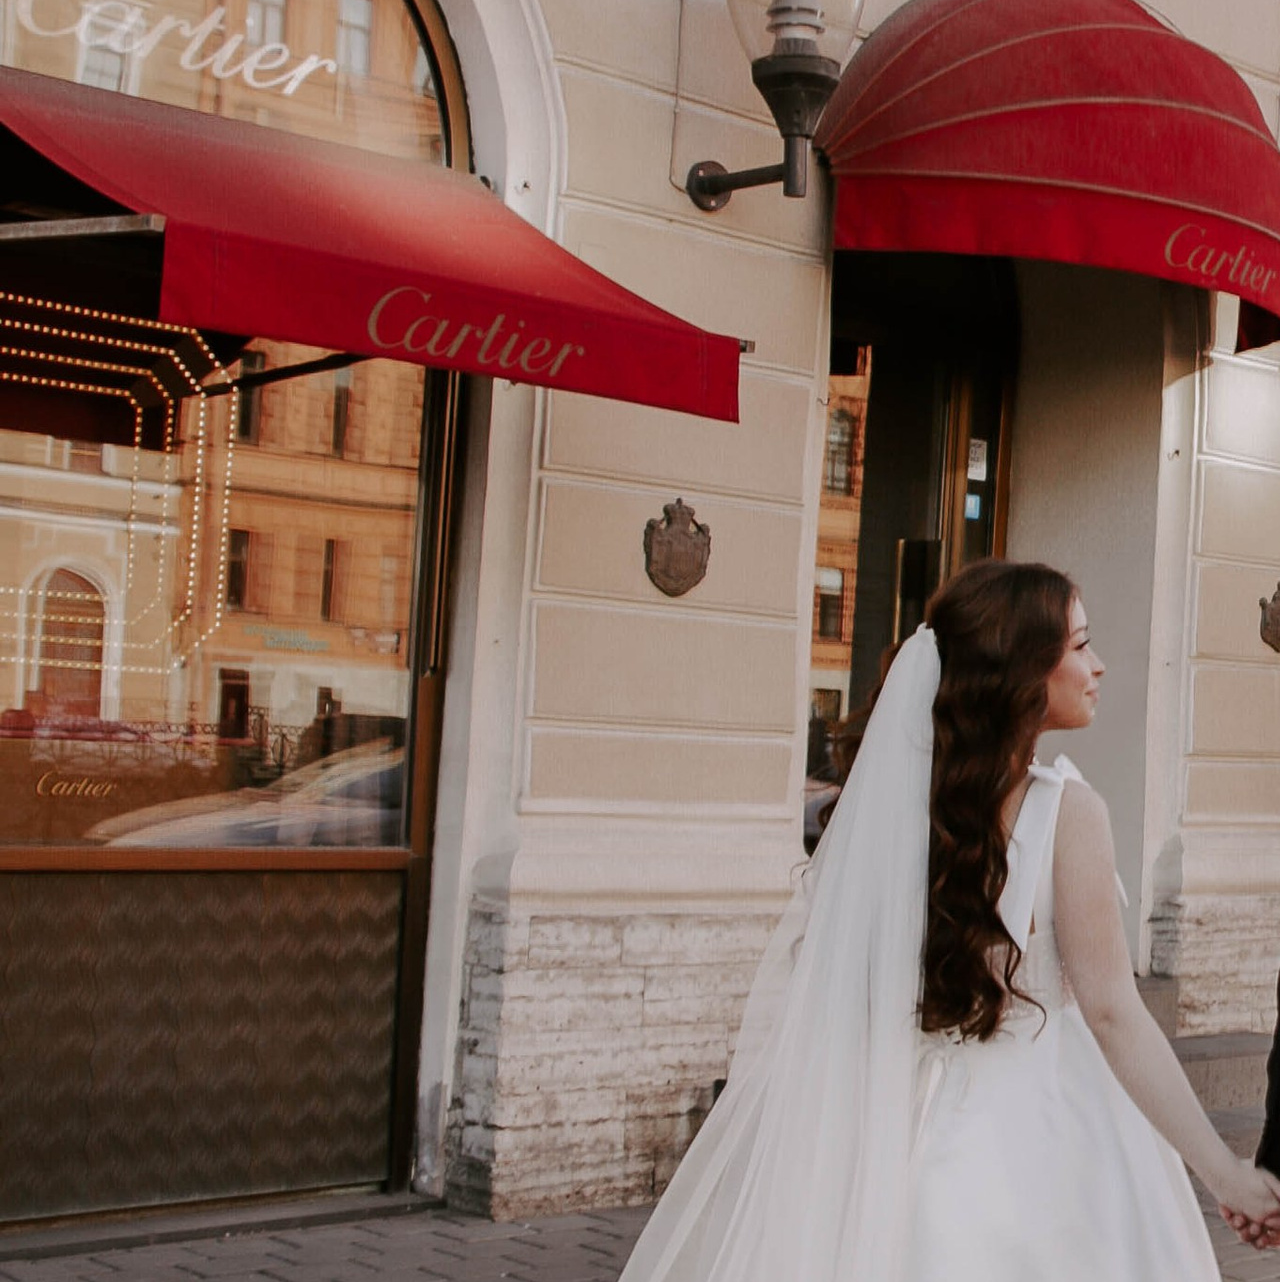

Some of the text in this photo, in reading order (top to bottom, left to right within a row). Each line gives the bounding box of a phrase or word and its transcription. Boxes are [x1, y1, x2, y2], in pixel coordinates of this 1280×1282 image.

[1164, 222, 1277, 292] Cartier
[367, 285, 585, 377] Cartier
[36, 770, 118, 798] Cartier
